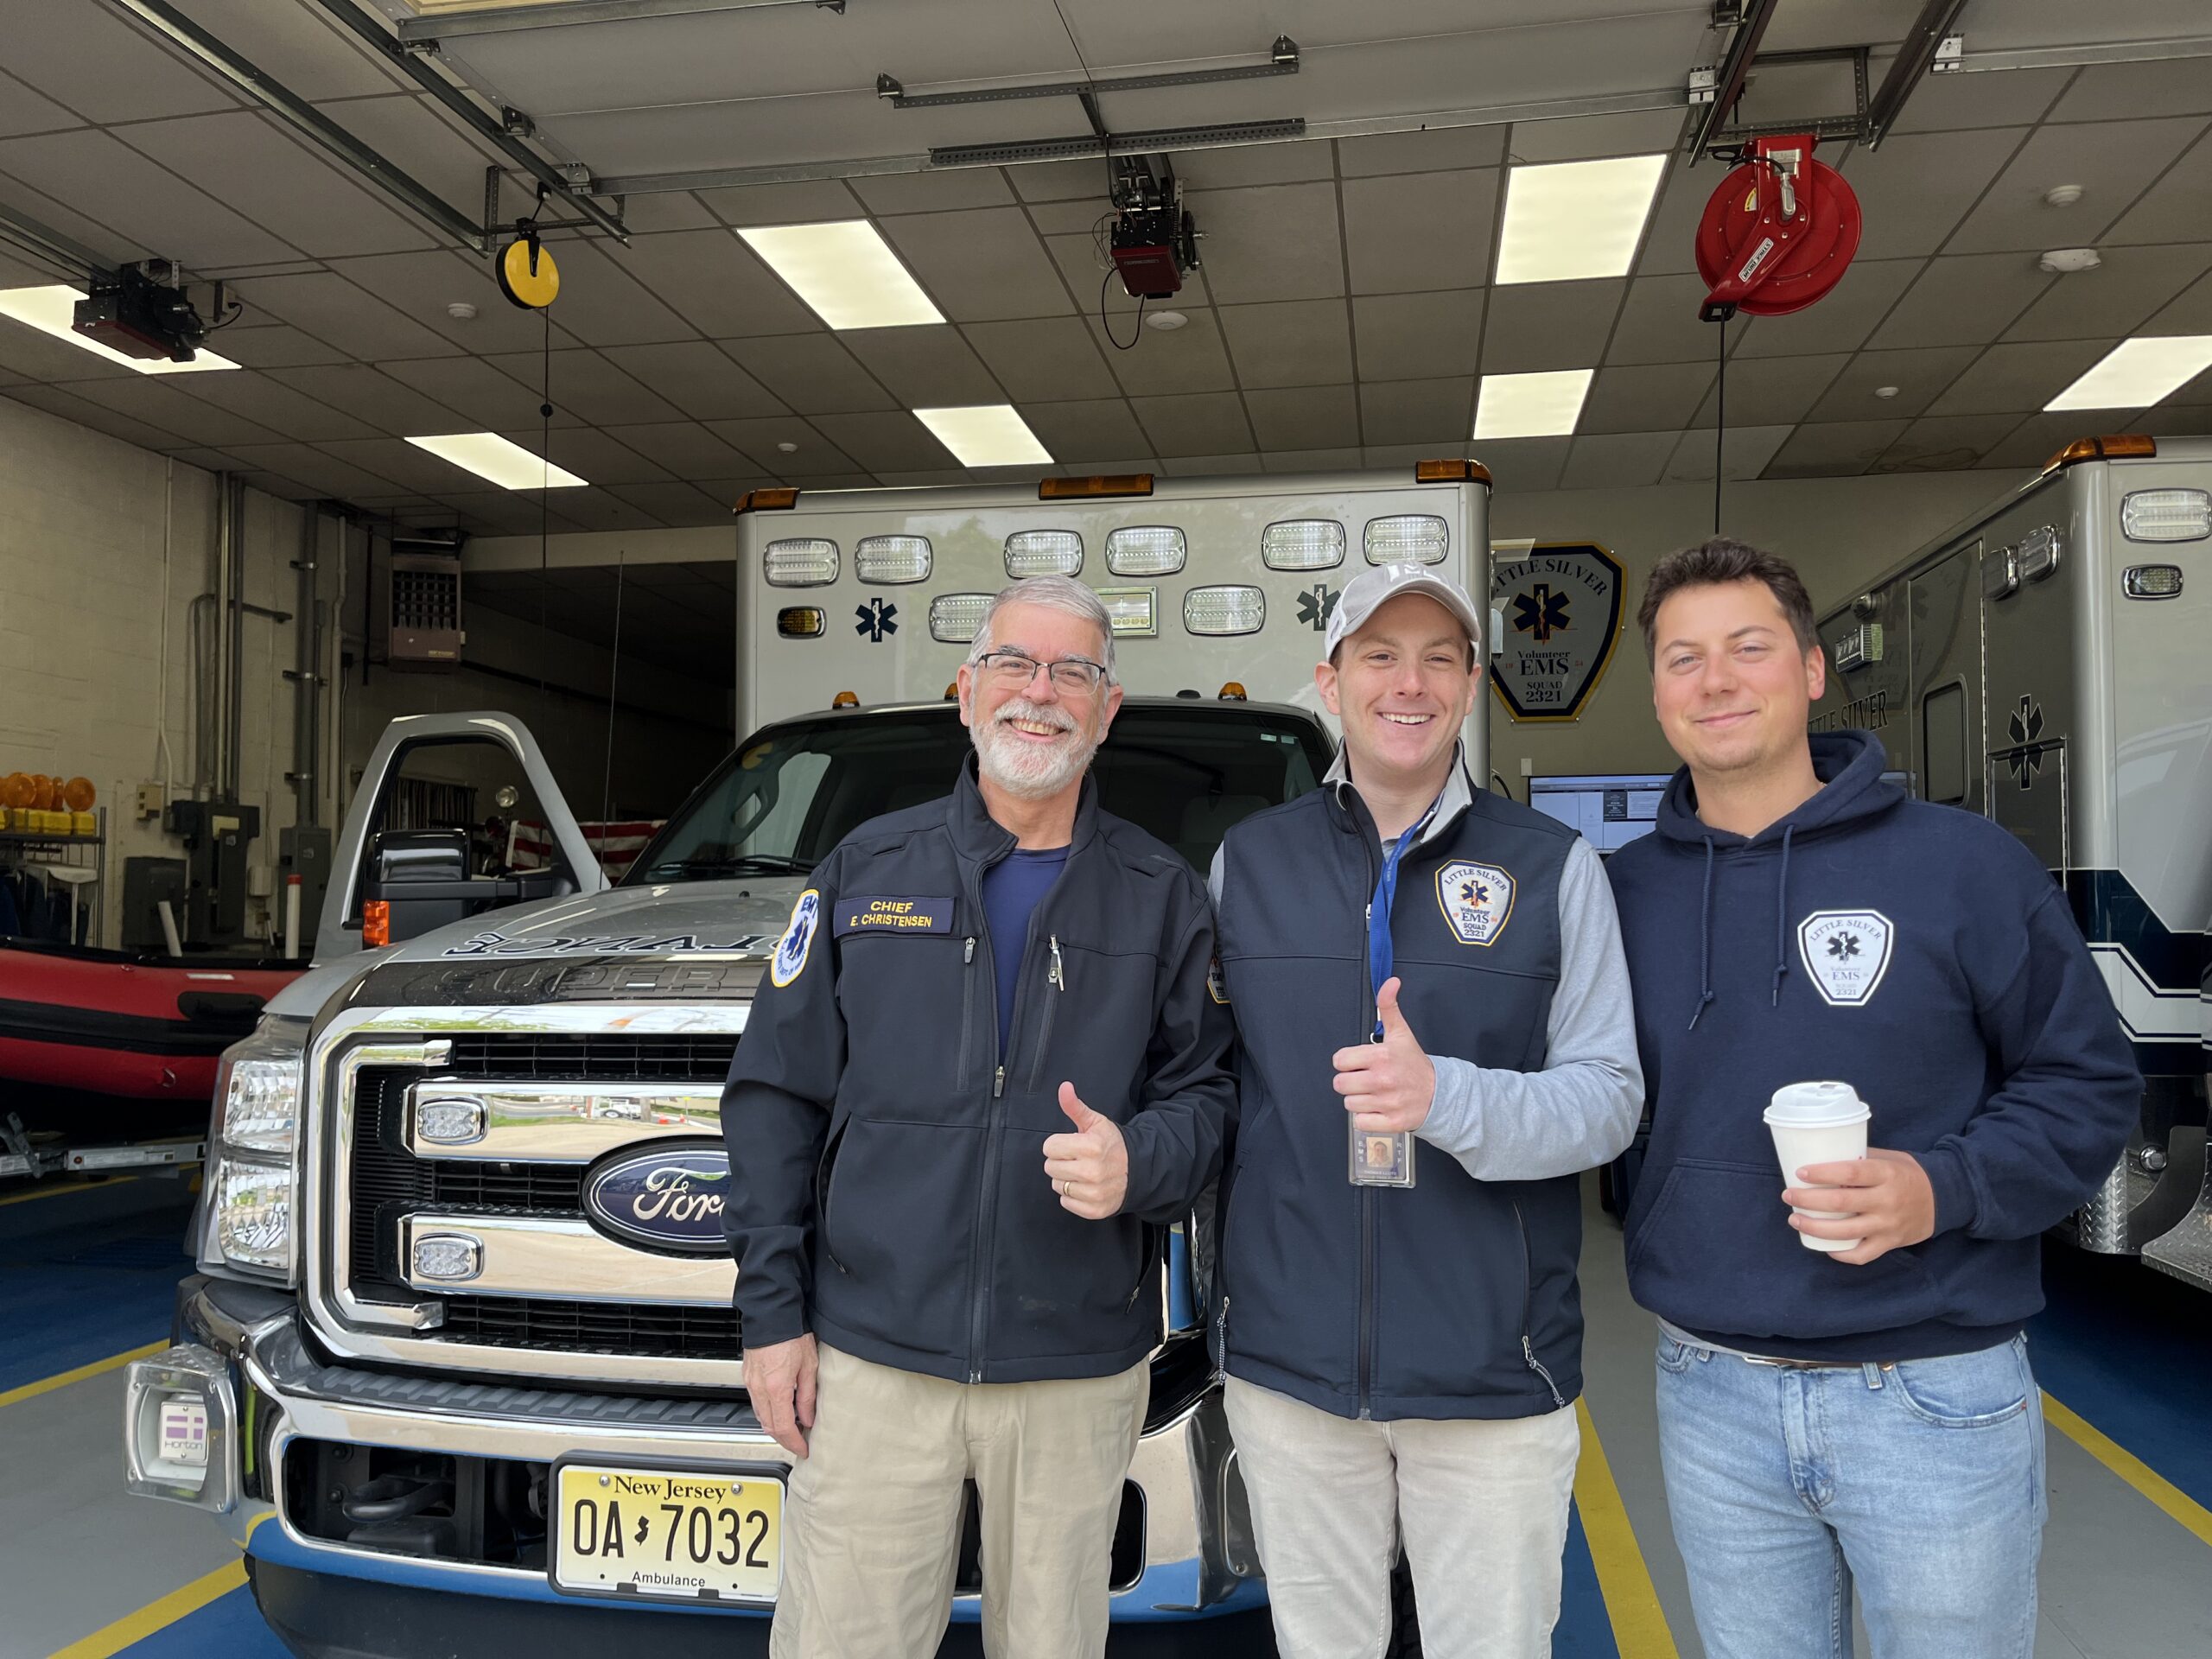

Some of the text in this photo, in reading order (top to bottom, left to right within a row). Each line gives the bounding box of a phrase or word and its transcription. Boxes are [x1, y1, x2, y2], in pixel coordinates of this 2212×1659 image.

[1496, 558, 1607, 596] TTLE SILVER
[1521, 658, 1569, 676] EMS
[1527, 681, 1563, 691] SQUAD
[1526, 690, 1561, 702] 2321
[1808, 710, 1836, 733] TTLE
[1445, 868, 1508, 892] LITTLE SILVER
[870, 900, 913, 913] CHIEF
[1460, 906, 1491, 916] Volunteer
[850, 914, 932, 928] E. CHRISTENSEN
[1462, 912, 1490, 924] EMS
[1465, 929, 1484, 938] 2321
[1810, 919, 1882, 941] LITTLE SILVER
[434, 965, 728, 1001] SUPER
[1832, 971, 1859, 981] EMS
[632, 1166, 728, 1222] For
[164, 1440, 203, 1450] Horton
[613, 1475, 728, 1504] New Jersey
[660, 1503, 770, 1568] 7032
[632, 1571, 706, 1588] Ambulance
